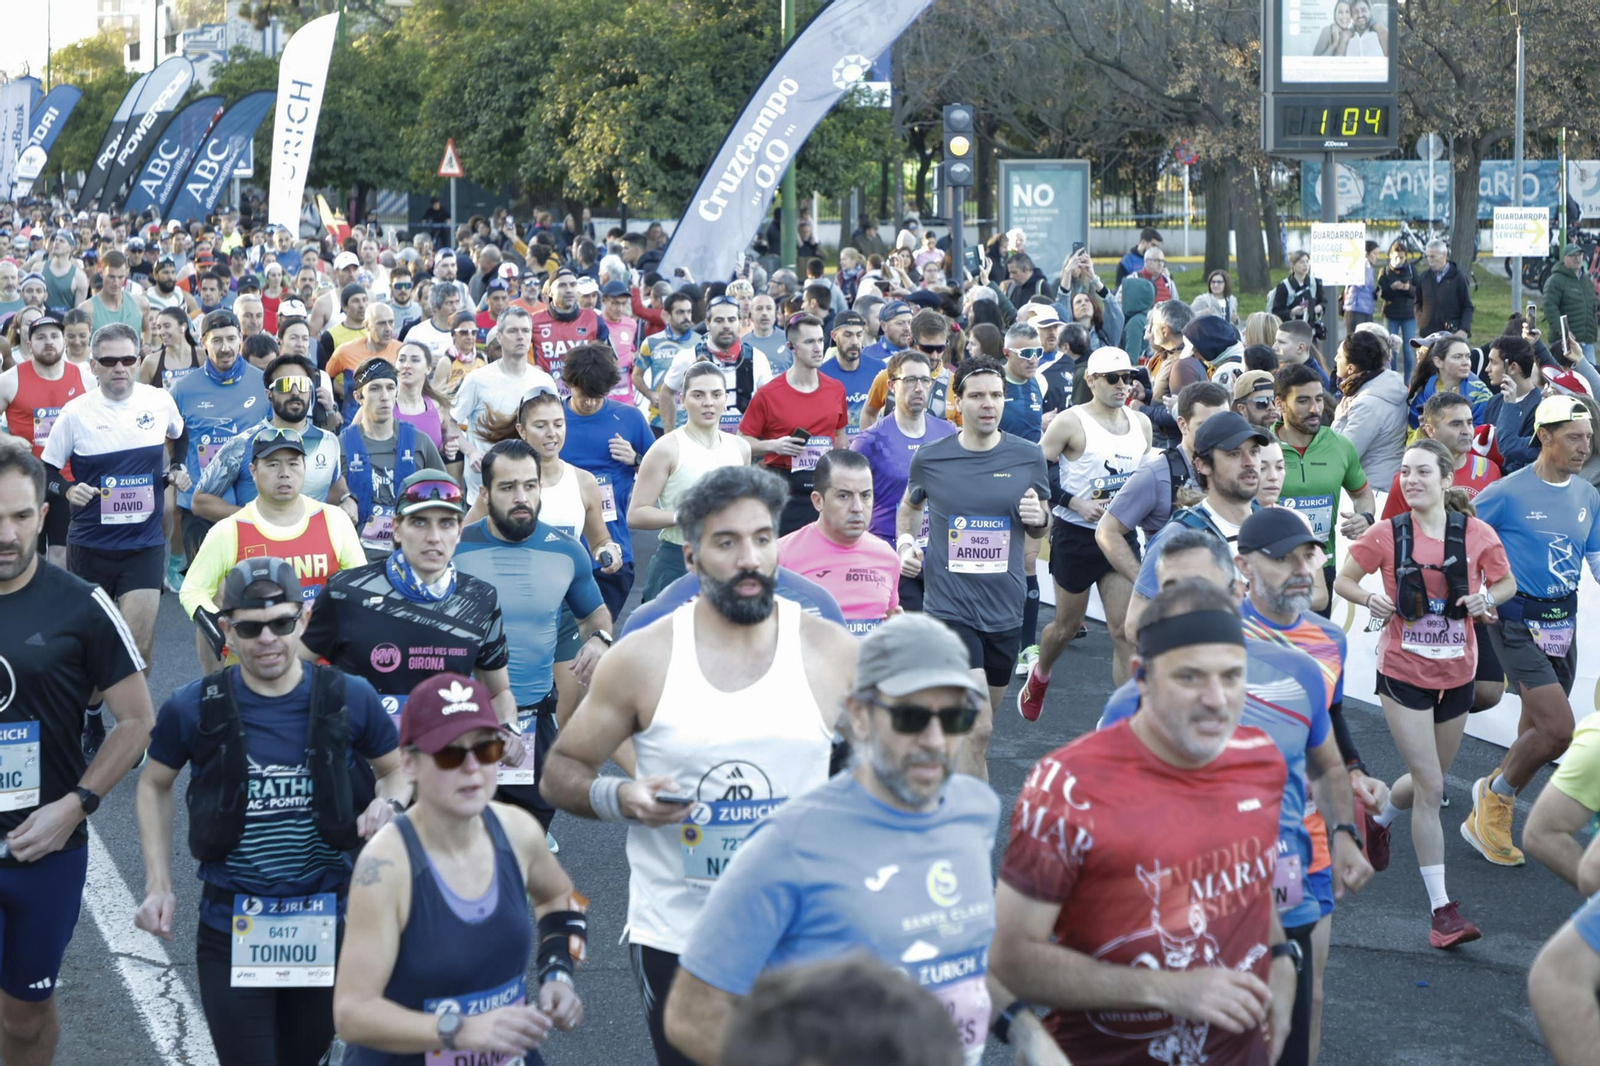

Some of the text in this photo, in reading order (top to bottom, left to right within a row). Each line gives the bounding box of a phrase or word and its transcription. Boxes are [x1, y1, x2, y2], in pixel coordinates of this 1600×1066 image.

[117, 69, 190, 167] POWERADE
[698, 78, 799, 222] Cruzcampo
[139, 138, 180, 199] ABC
[186, 138, 230, 204] ABC
[1013, 184, 1055, 207] NO
[1313, 231, 1364, 240] GUARDARROPA
[1495, 231, 1524, 239] SERVICE
[1313, 243, 1343, 252] BAGGAGE
[1313, 254, 1340, 263] SERVICE
[807, 438, 831, 446] ZURICH
[120, 477, 148, 486] ZURICH
[113, 500, 143, 512] DAVID
[1299, 498, 1328, 506] ZURICH
[970, 520, 1004, 528] ZURICH
[957, 547, 1002, 559] ARNOUT
[1427, 620, 1446, 628] 9993
[1403, 631, 1450, 643] PALOMA
[408, 657, 445, 670] GIRONA
[442, 703, 479, 715] adidas
[269, 900, 324, 913] ZURICH
[269, 926, 298, 939] 6417
[249, 944, 317, 963] TOINOU
[919, 956, 976, 986] ZURICH
[468, 984, 520, 1016] ZURICH
